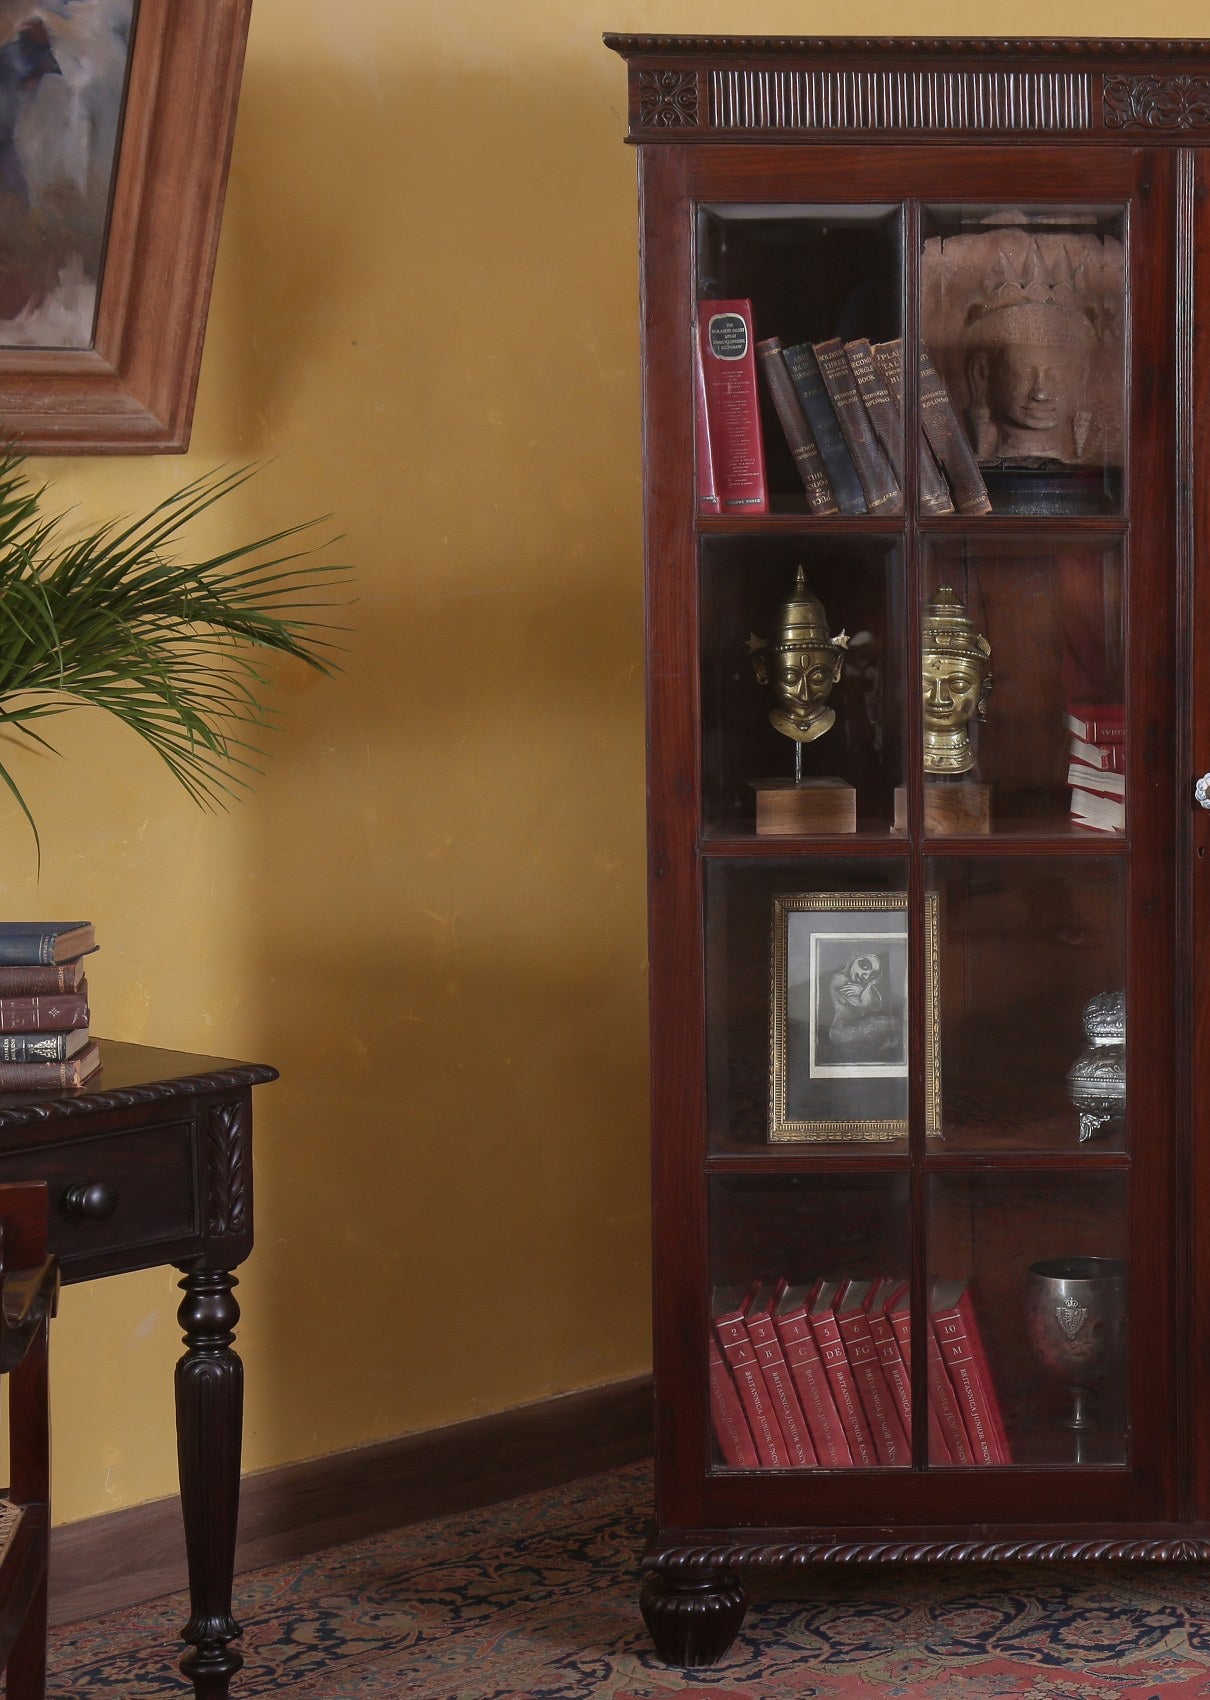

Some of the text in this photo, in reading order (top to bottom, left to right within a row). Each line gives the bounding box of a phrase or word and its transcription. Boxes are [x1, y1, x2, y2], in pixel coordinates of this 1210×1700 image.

[857, 373, 876, 385] BOOK
[731, 1328, 738, 1337] 2
[758, 1328, 766, 1337] 3
[824, 1328, 831, 1337] 5
[853, 1324, 860, 1333] 6
[877, 1326, 883, 1335] 7
[944, 1324, 956, 1334] 10
[738, 1350, 746, 1358] A
[765, 1349, 773, 1359] B
[798, 1347, 807, 1356] C
[826, 1348, 842, 1359] DE
[855, 1345, 870, 1356] FG
[952, 1345, 963, 1356] M
[805, 1369, 824, 1413] BRITANNICA
[892, 1369, 911, 1414] BRITANNICA
[745, 1371, 763, 1415] BRITANNICA
[757, 1414, 773, 1443] JUNIOR
[772, 1372, 791, 1415] BRITANNICA
[785, 1414, 800, 1443] JUNIOR
[836, 1371, 854, 1415] BRITANNICA
[849, 1414, 864, 1443] JUNIOR
[865, 1368, 882, 1414] BRITANNICA
[877, 1412, 892, 1440] JUNIOR
[960, 1368, 978, 1412] BRITANNICA
[970, 1411, 985, 1440] JUNIOR
